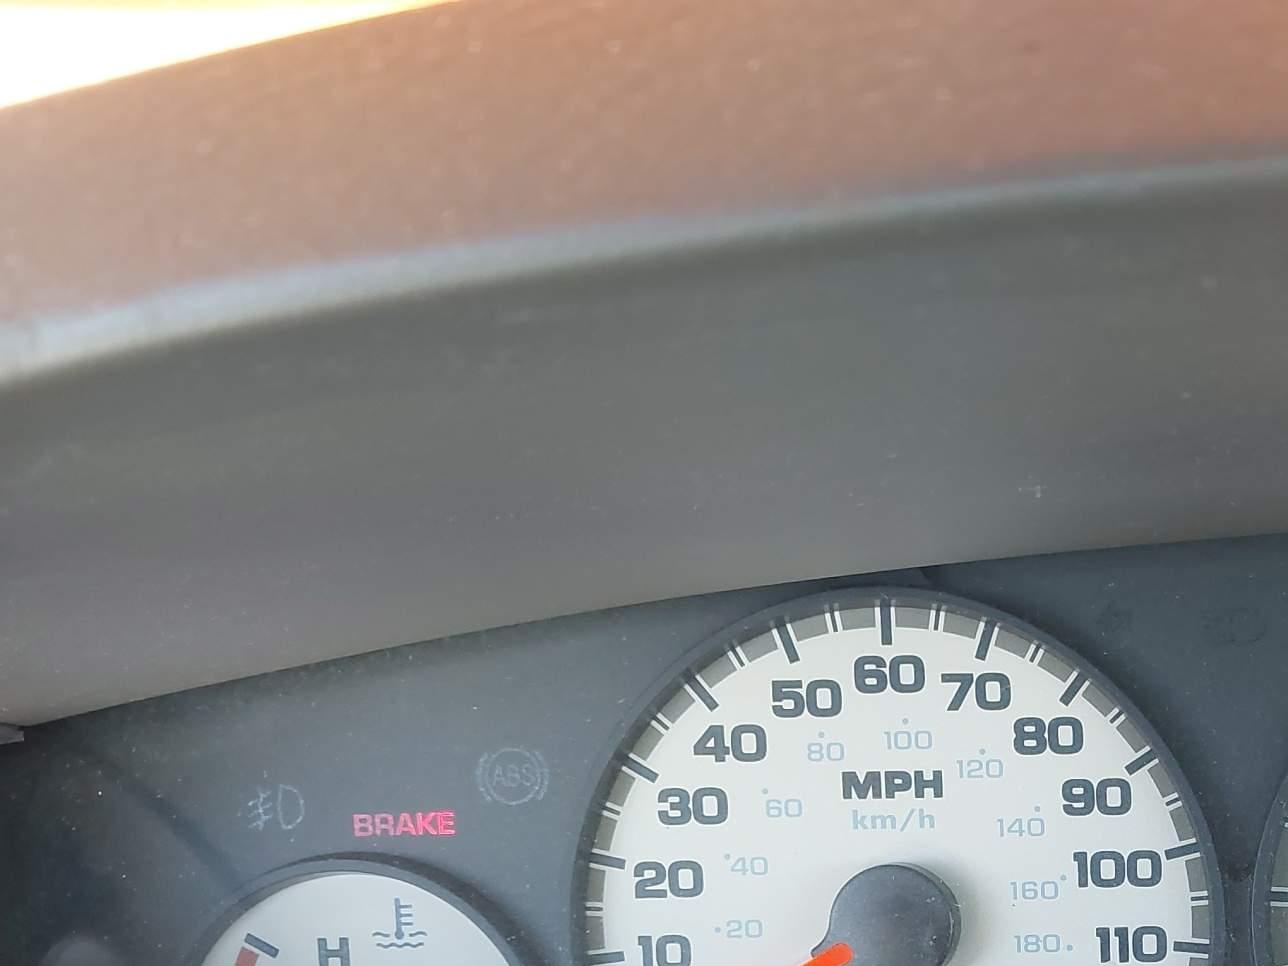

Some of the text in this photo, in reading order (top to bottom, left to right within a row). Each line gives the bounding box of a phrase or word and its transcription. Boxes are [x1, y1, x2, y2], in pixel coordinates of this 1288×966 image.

[853, 655, 925, 693] 60
[771, 680, 842, 717] 50
[940, 672, 1011, 711] 70
[693, 724, 767, 761] 40
[882, 731, 932, 750] 100
[1013, 717, 1083, 754] 80
[807, 742, 844, 762] 80
[956, 759, 1003, 778] 120
[841, 770, 943, 799] MPH
[1061, 778, 1131, 815] 90
[657, 787, 728, 824] 30
[765, 799, 802, 818] 60
[353, 813, 456, 836] BRAKE
[851, 809, 935, 833] km/h
[997, 818, 1044, 837] 140
[633, 860, 704, 897] 20
[730, 856, 768, 875] 40
[1073, 850, 1162, 888] 100
[1010, 880, 1058, 900] 160
[726, 919, 763, 939] 20
[1014, 934, 1060, 953] 180
[1095, 926, 1167, 963] 110
